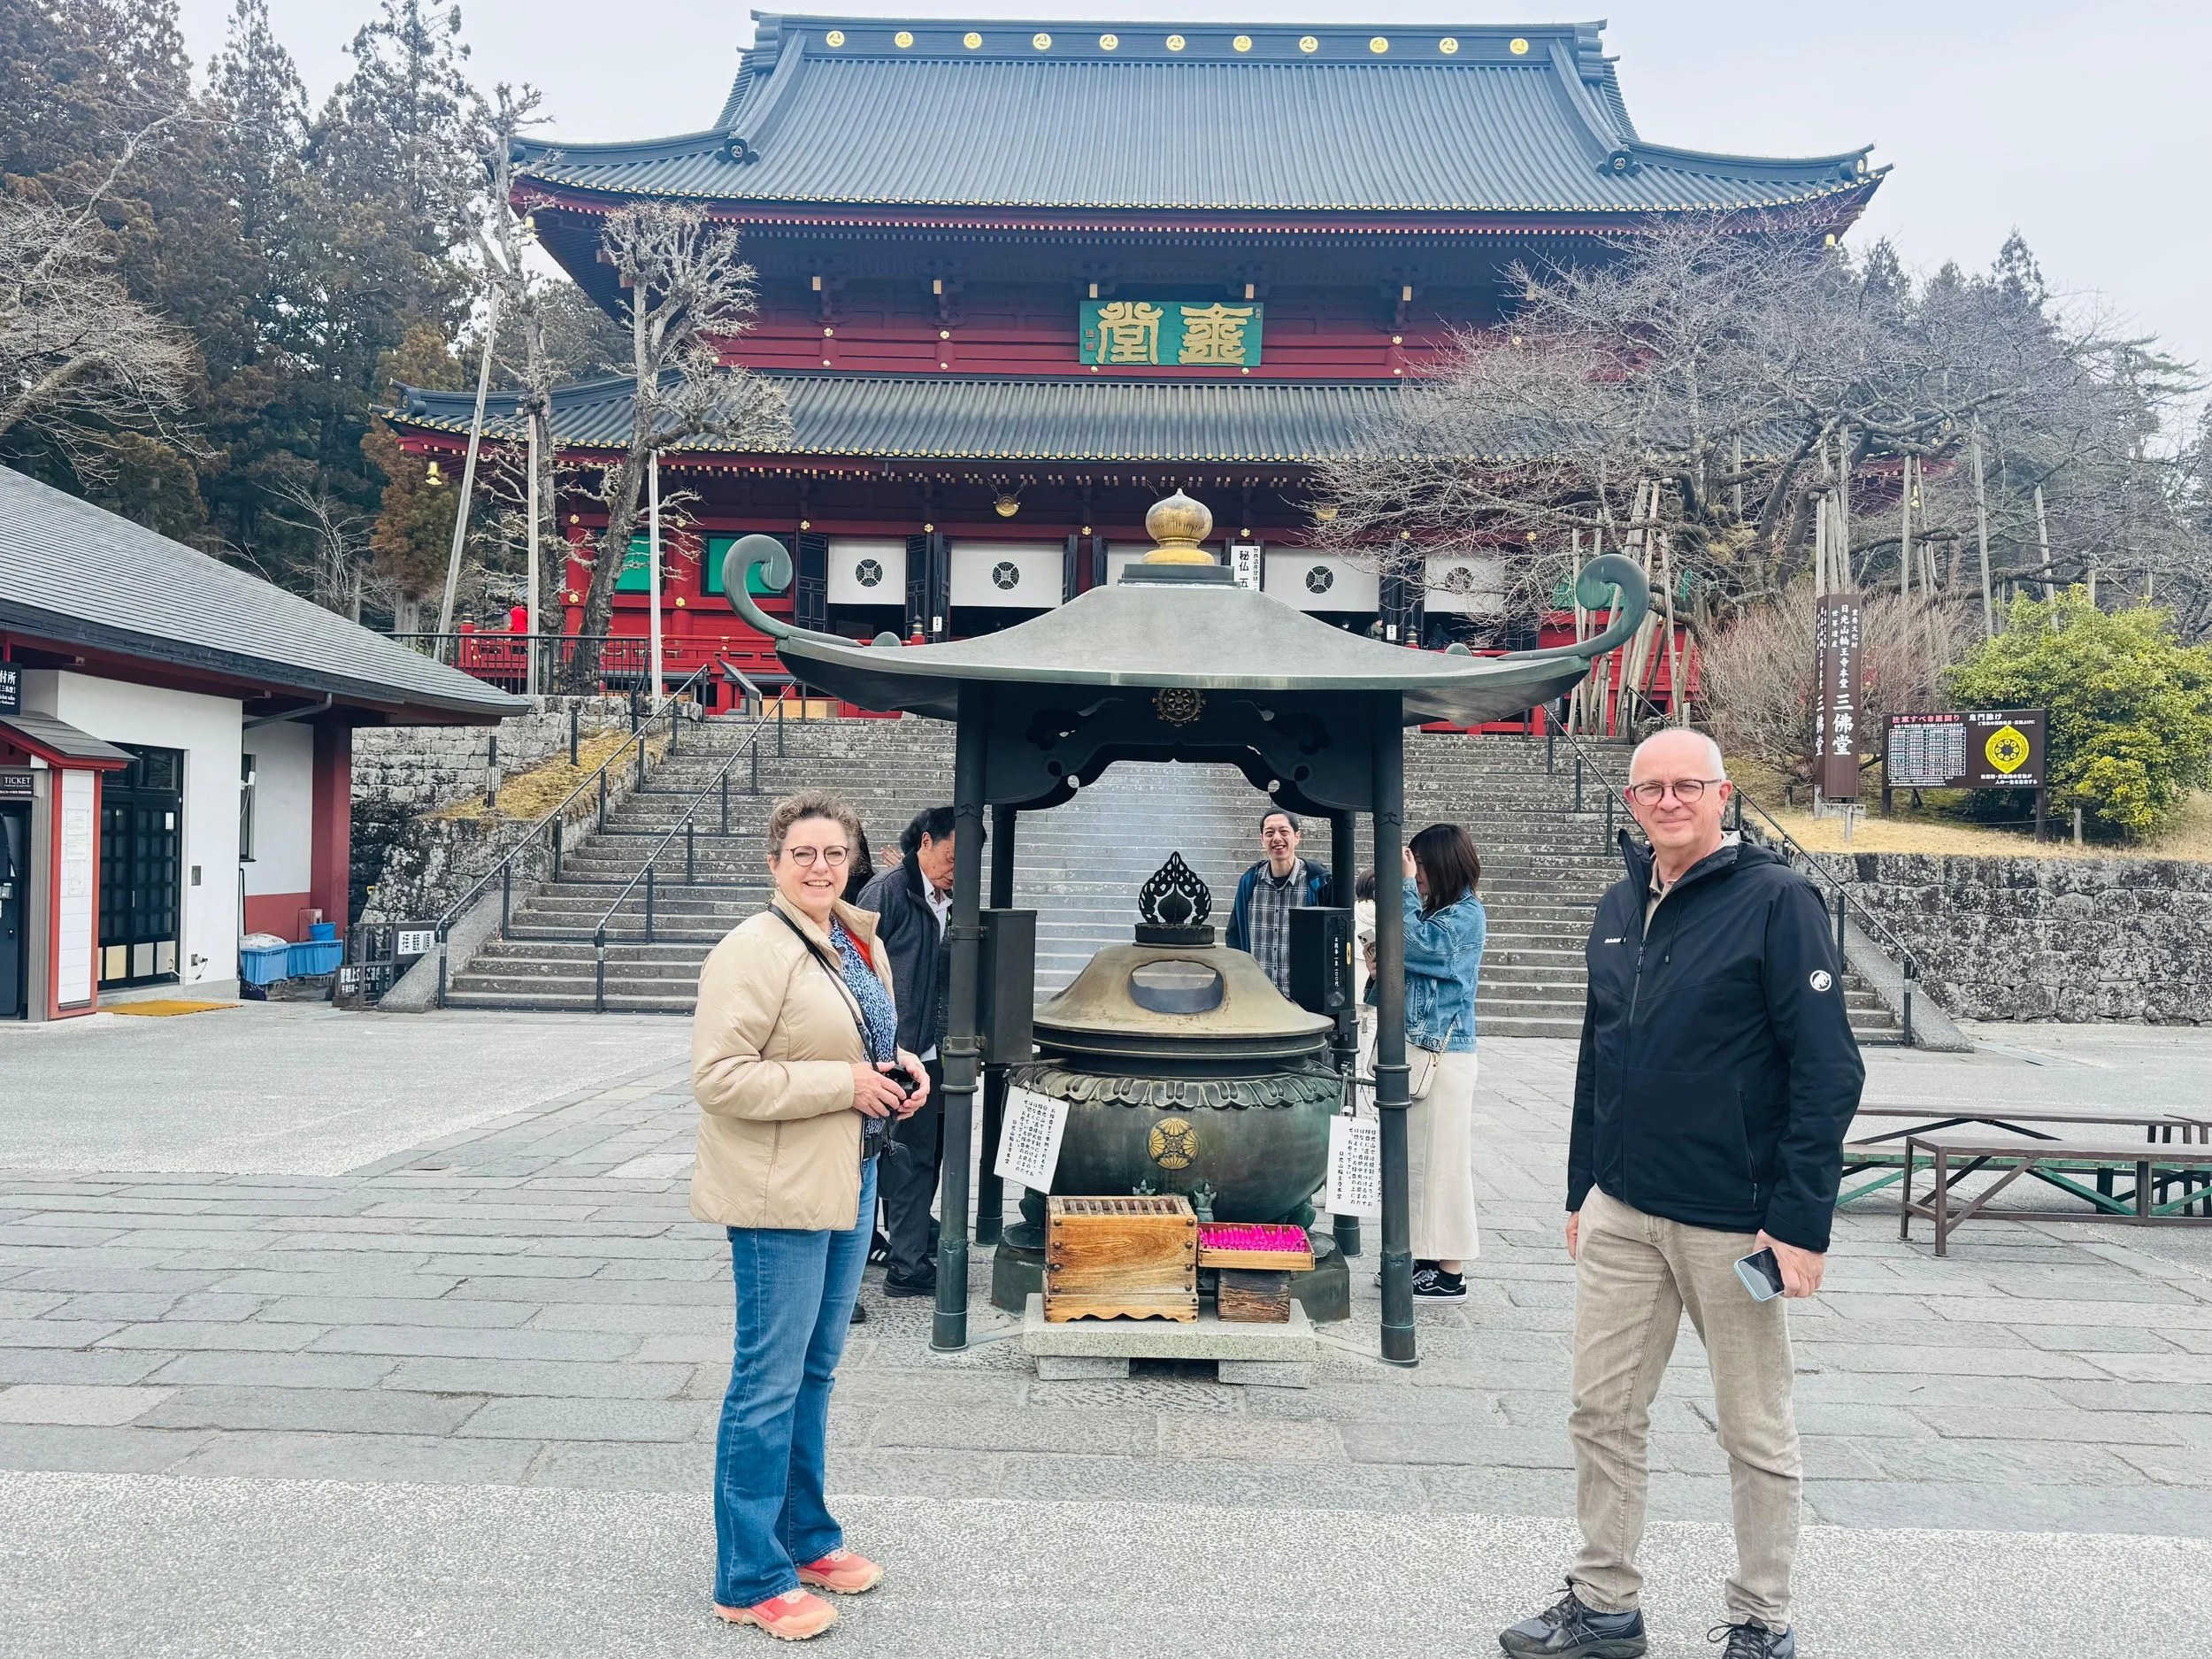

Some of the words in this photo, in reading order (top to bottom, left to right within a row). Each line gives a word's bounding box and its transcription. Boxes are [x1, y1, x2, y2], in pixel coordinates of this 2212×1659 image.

[1239, 549, 1249, 572] 秘仏
[1839, 603, 1850, 688] 日光山輪王寺本堂
[1832, 693, 1855, 757] 三佛堂
[4, 776, 31, 785] TICKET
